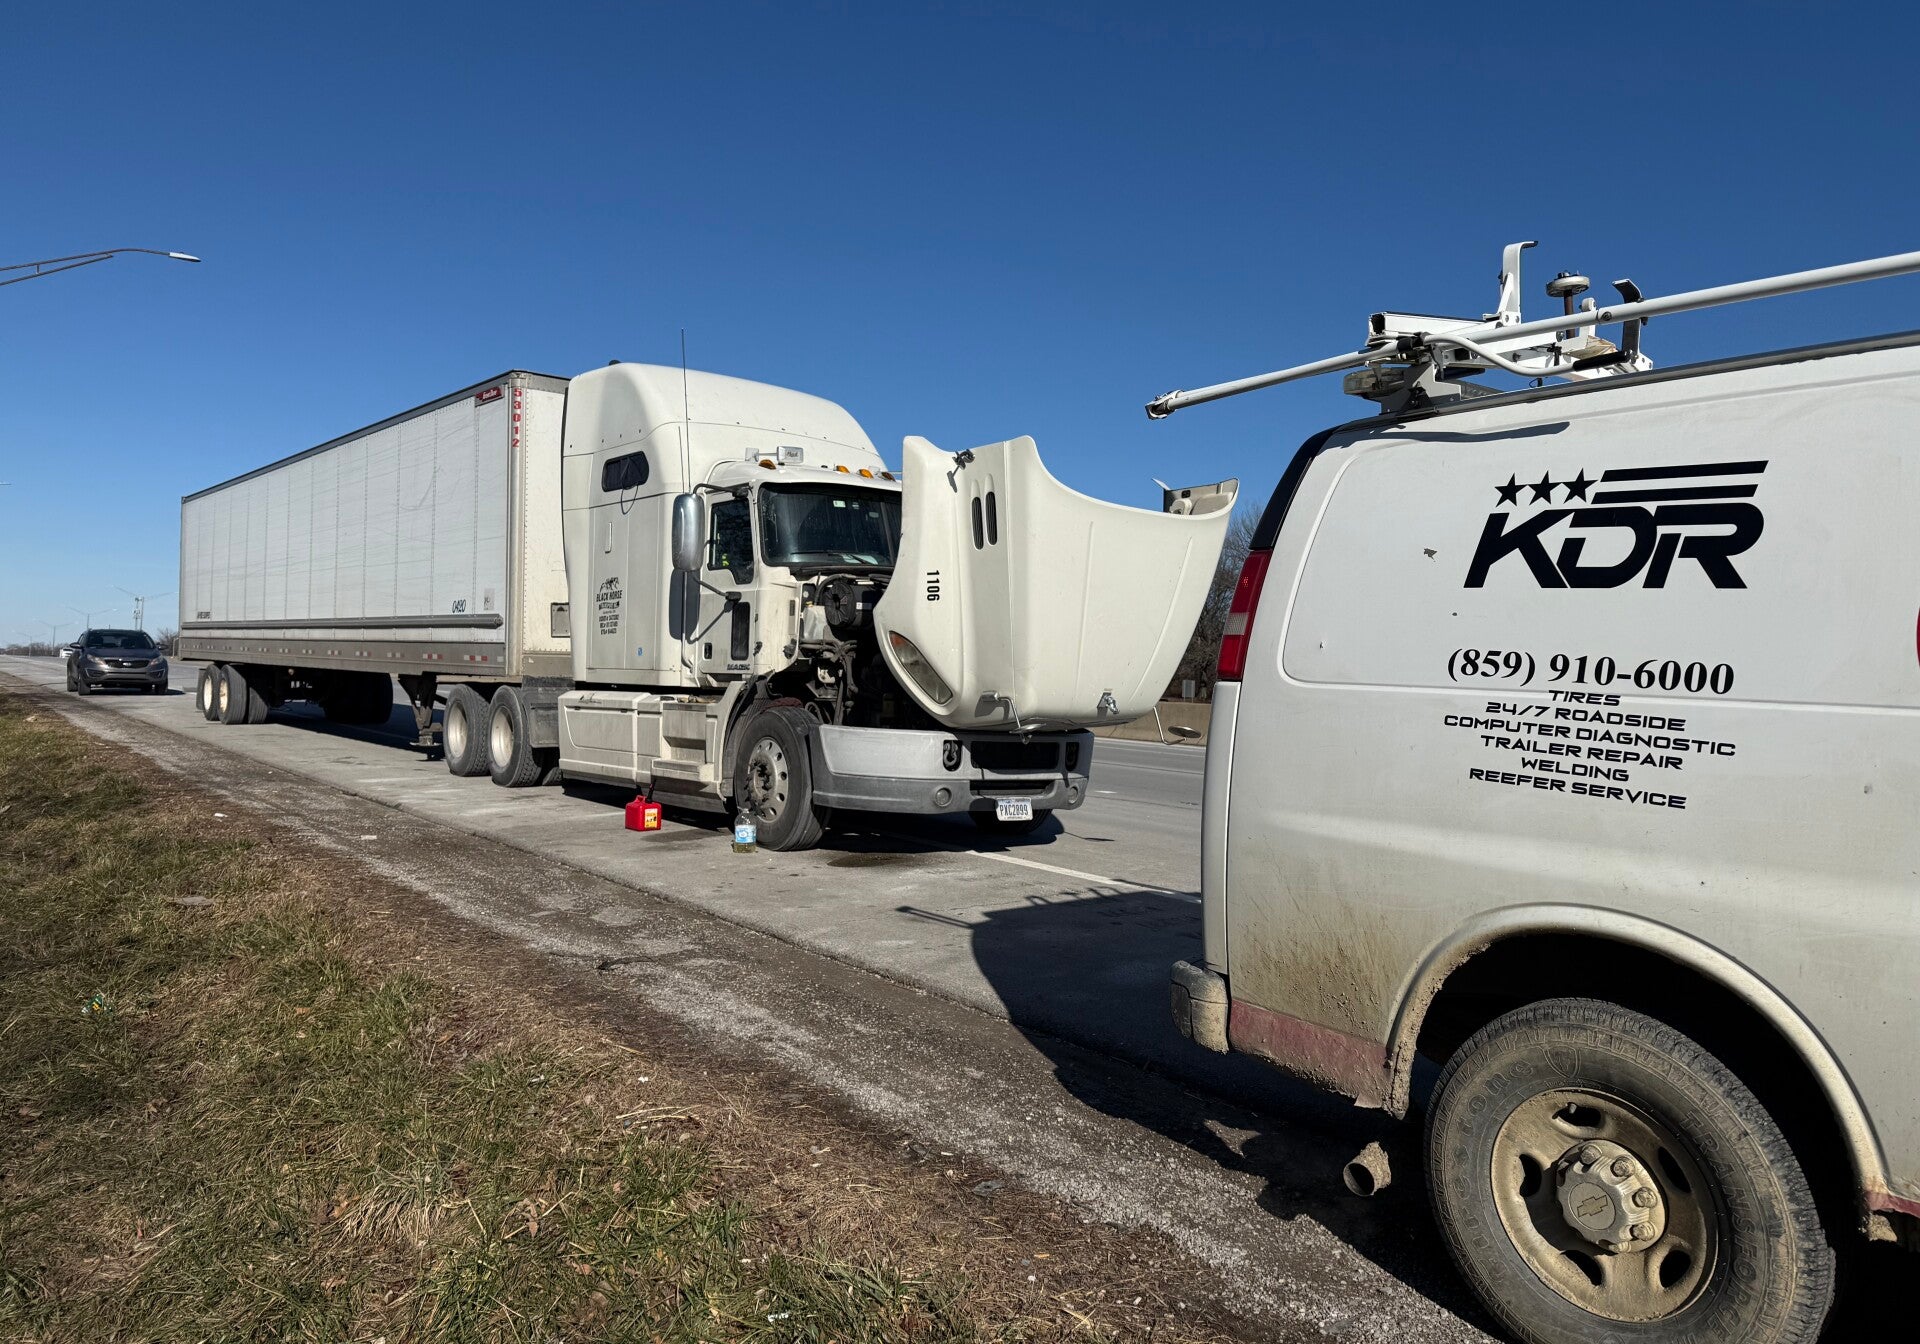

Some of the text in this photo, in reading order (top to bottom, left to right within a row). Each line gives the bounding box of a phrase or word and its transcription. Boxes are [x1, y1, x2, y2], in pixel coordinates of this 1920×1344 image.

[511, 387, 522, 448] 53012
[1463, 502, 1764, 589] KDR
[926, 569, 940, 601] 1106
[1447, 648, 1735, 695] (859) 910-6000
[1485, 701, 1687, 732] 24/7 ROADSIDE
[1548, 689, 1621, 707] TIRES
[1443, 714, 1736, 757] COMPUTER DIAGNOSTIC
[1480, 734, 1683, 771] TRAILER REPAIR
[1469, 767, 1687, 810] REEFER SERVICE
[1521, 756, 1630, 782] WELDING
